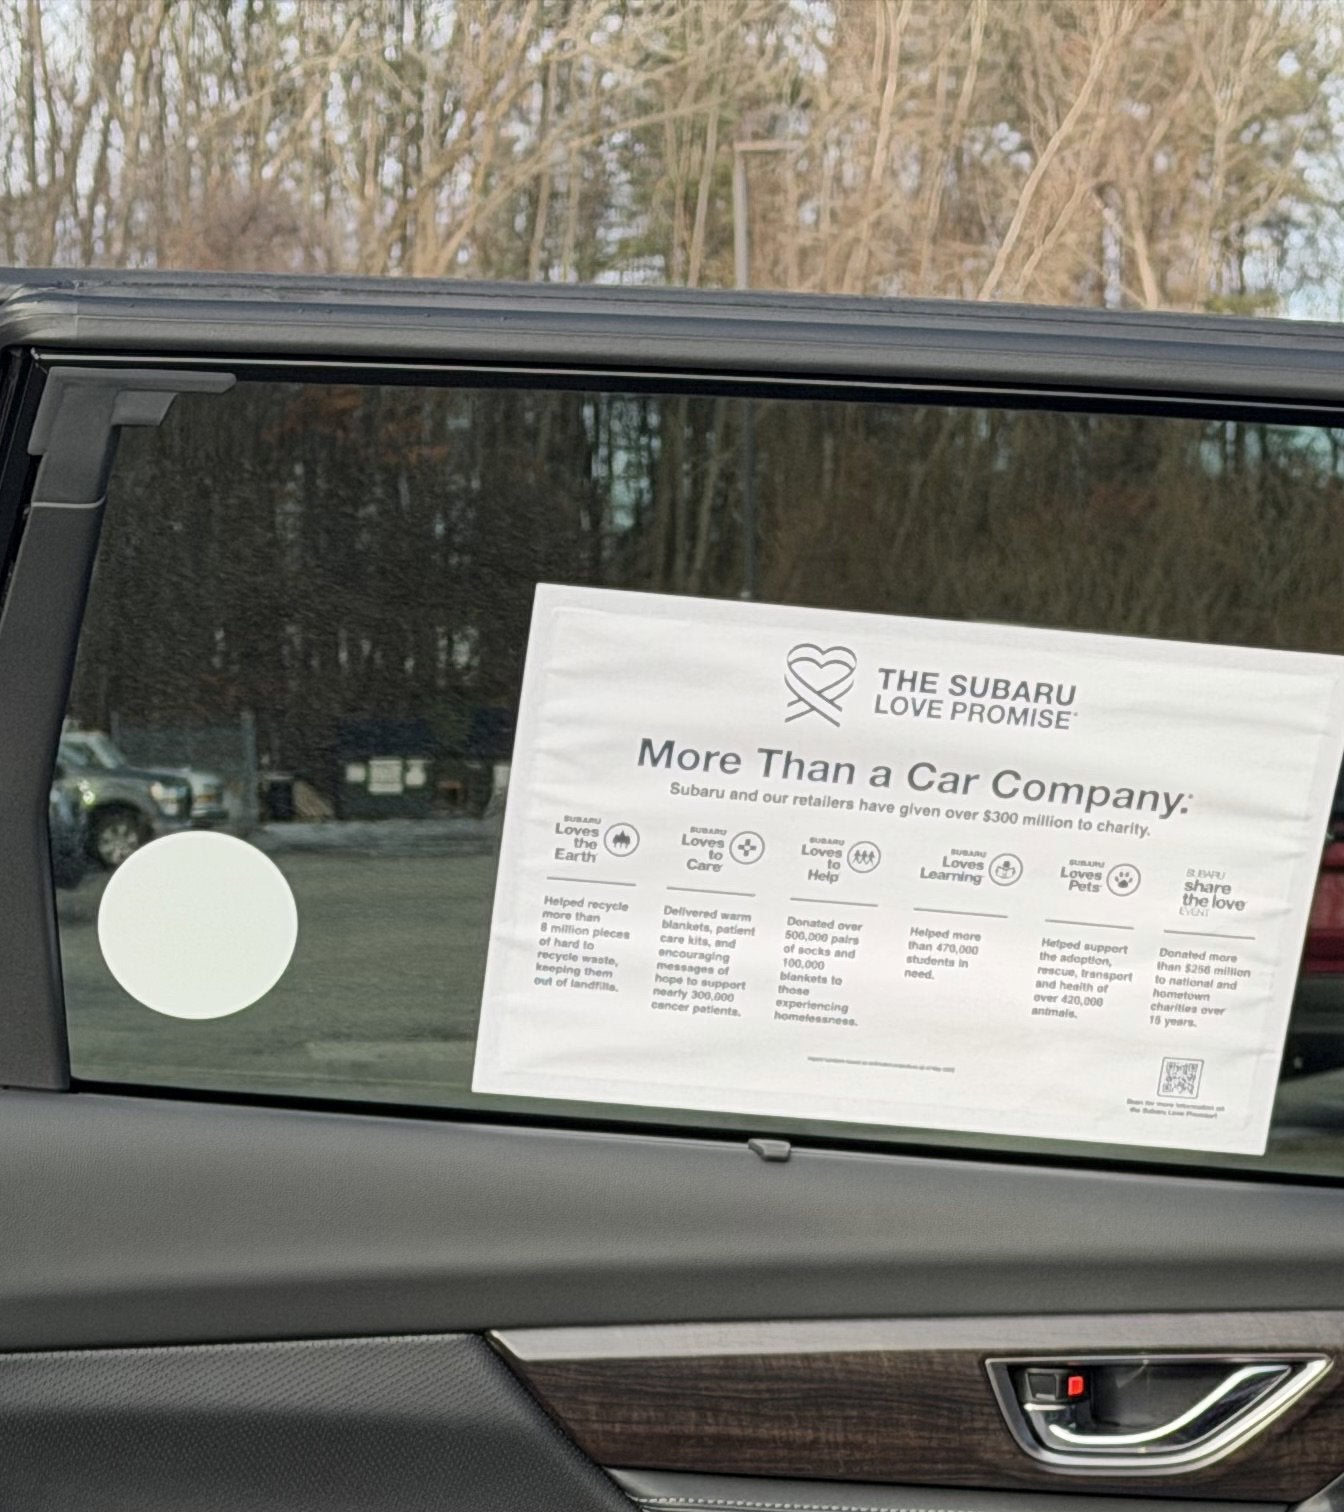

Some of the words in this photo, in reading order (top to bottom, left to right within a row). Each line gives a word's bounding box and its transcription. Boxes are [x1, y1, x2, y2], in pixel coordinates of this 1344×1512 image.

[878, 667, 939, 694] THE
[948, 674, 1076, 706] SUBARU
[874, 694, 943, 719] LOVE
[637, 738, 741, 774] More
[757, 748, 855, 785] Than
[869, 766, 892, 788] a
[907, 762, 980, 795] Car
[670, 781, 725, 799] Subaru
[729, 789, 759, 802] and
[762, 793, 789, 804] our
[792, 794, 854, 810] retailers
[859, 798, 895, 814] have
[899, 803, 941, 818] given
[945, 809, 979, 821] over
[982, 809, 1019, 825] $300
[1022, 814, 1073, 829] million
[1078, 818, 1093, 831] to
[1096, 820, 1150, 839] charity.
[555, 822, 599, 838] Loves
[574, 837, 598, 850] the
[681, 833, 725, 849] Loves
[554, 847, 596, 863] Earth
[708, 849, 724, 861] to
[801, 844, 843, 859] Loves
[686, 858, 723, 872] Care
[827, 859, 841, 870] to
[942, 855, 984, 871] Loves
[808, 869, 839, 884] Help
[920, 867, 984, 886] Learning
[1060, 866, 1102, 881] Loves
[1068, 879, 1102, 893] Pets
[1184, 879, 1232, 895] share
[544, 895, 585, 909] Helped
[587, 901, 629, 913] recycle
[1182, 893, 1209, 908] the
[1212, 894, 1246, 911] love
[542, 910, 572, 920] more
[575, 911, 601, 922] than
[663, 905, 718, 919] Delivered
[720, 913, 752, 922] warm
[661, 919, 713, 934] blankets,
[715, 924, 756, 937] patient
[787, 916, 835, 930] Donated
[837, 922, 863, 931] over
[550, 924, 590, 935] million
[592, 927, 630, 940] pieces
[830, 934, 859, 945] pairs
[910, 927, 950, 939] Helped
[952, 932, 982, 942] more
[538, 936, 551, 947] of
[553, 937, 580, 949] hard
[583, 940, 595, 950] to
[659, 934, 685, 944] care
[688, 935, 711, 948] kits,
[714, 939, 737, 949] and
[908, 940, 933, 951] than
[1041, 937, 1081, 950] Helped
[1084, 943, 1128, 955] support
[537, 951, 579, 963] recycle
[582, 955, 618, 967] waste,
[658, 948, 730, 964] encouraging
[783, 944, 795, 954] of
[798, 946, 831, 957] socks
[834, 949, 856, 959] and
[1159, 947, 1207, 961] Donated
[1209, 954, 1238, 963] more
[906, 955, 955, 967] students
[958, 958, 969, 968] in
[1039, 951, 1058, 962] the
[1060, 954, 1112, 968] adoption,
[535, 962, 581, 977] keeping
[584, 967, 613, 978] them
[656, 962, 714, 975] messages
[717, 966, 730, 975] of
[1037, 966, 1078, 978] rescue,
[1081, 969, 1133, 982] transport
[1157, 961, 1182, 972] than
[1214, 967, 1251, 978] million
[533, 977, 553, 986] out
[555, 978, 568, 987] of
[654, 973, 684, 986] hope
[686, 976, 698, 986] to
[701, 979, 746, 991] support
[779, 971, 828, 985] blankets
[831, 975, 843, 986] to
[1155, 975, 1166, 985] to
[1169, 977, 1214, 988] national
[1216, 980, 1238, 990] and
[778, 984, 810, 996] those
[1035, 980, 1057, 989] and
[1059, 980, 1094, 992] health
[1096, 983, 1110, 993] of
[652, 988, 688, 1001] nearly
[1033, 994, 1059, 1003] over
[1152, 988, 1211, 1001] hometown
[651, 1001, 690, 1012] cancer
[775, 999, 849, 1015] experiencing
[1150, 1001, 1198, 1014] charities
[1200, 1007, 1226, 1015] over
